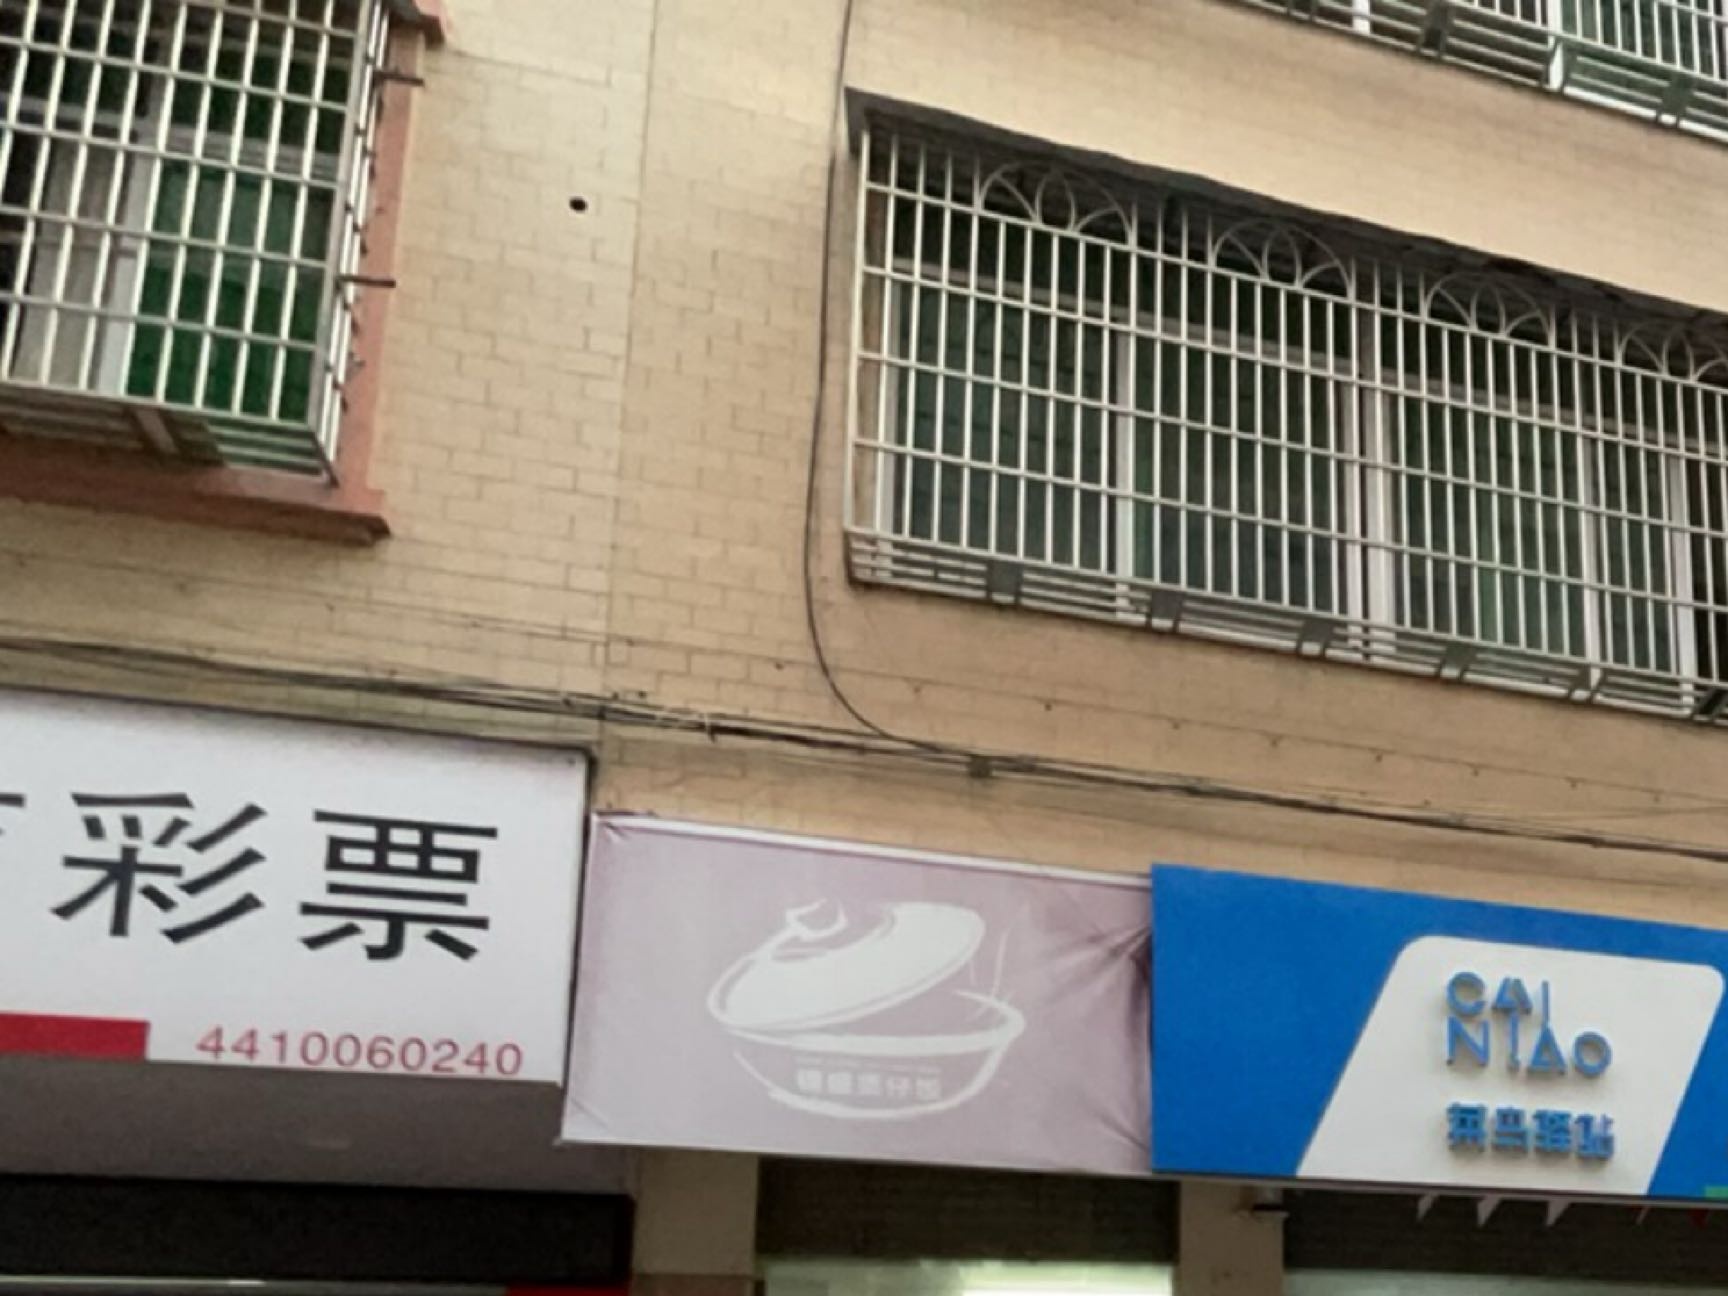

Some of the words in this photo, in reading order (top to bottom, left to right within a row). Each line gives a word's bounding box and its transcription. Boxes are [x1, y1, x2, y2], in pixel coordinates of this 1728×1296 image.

[0, 790, 499, 962] 彩票
[1445, 970, 1552, 1022] CAI
[195, 1024, 524, 1076] 4410060240
[1445, 1014, 1613, 1077] NIAO
[1445, 1101, 1616, 1162] 菜鸟驿站
